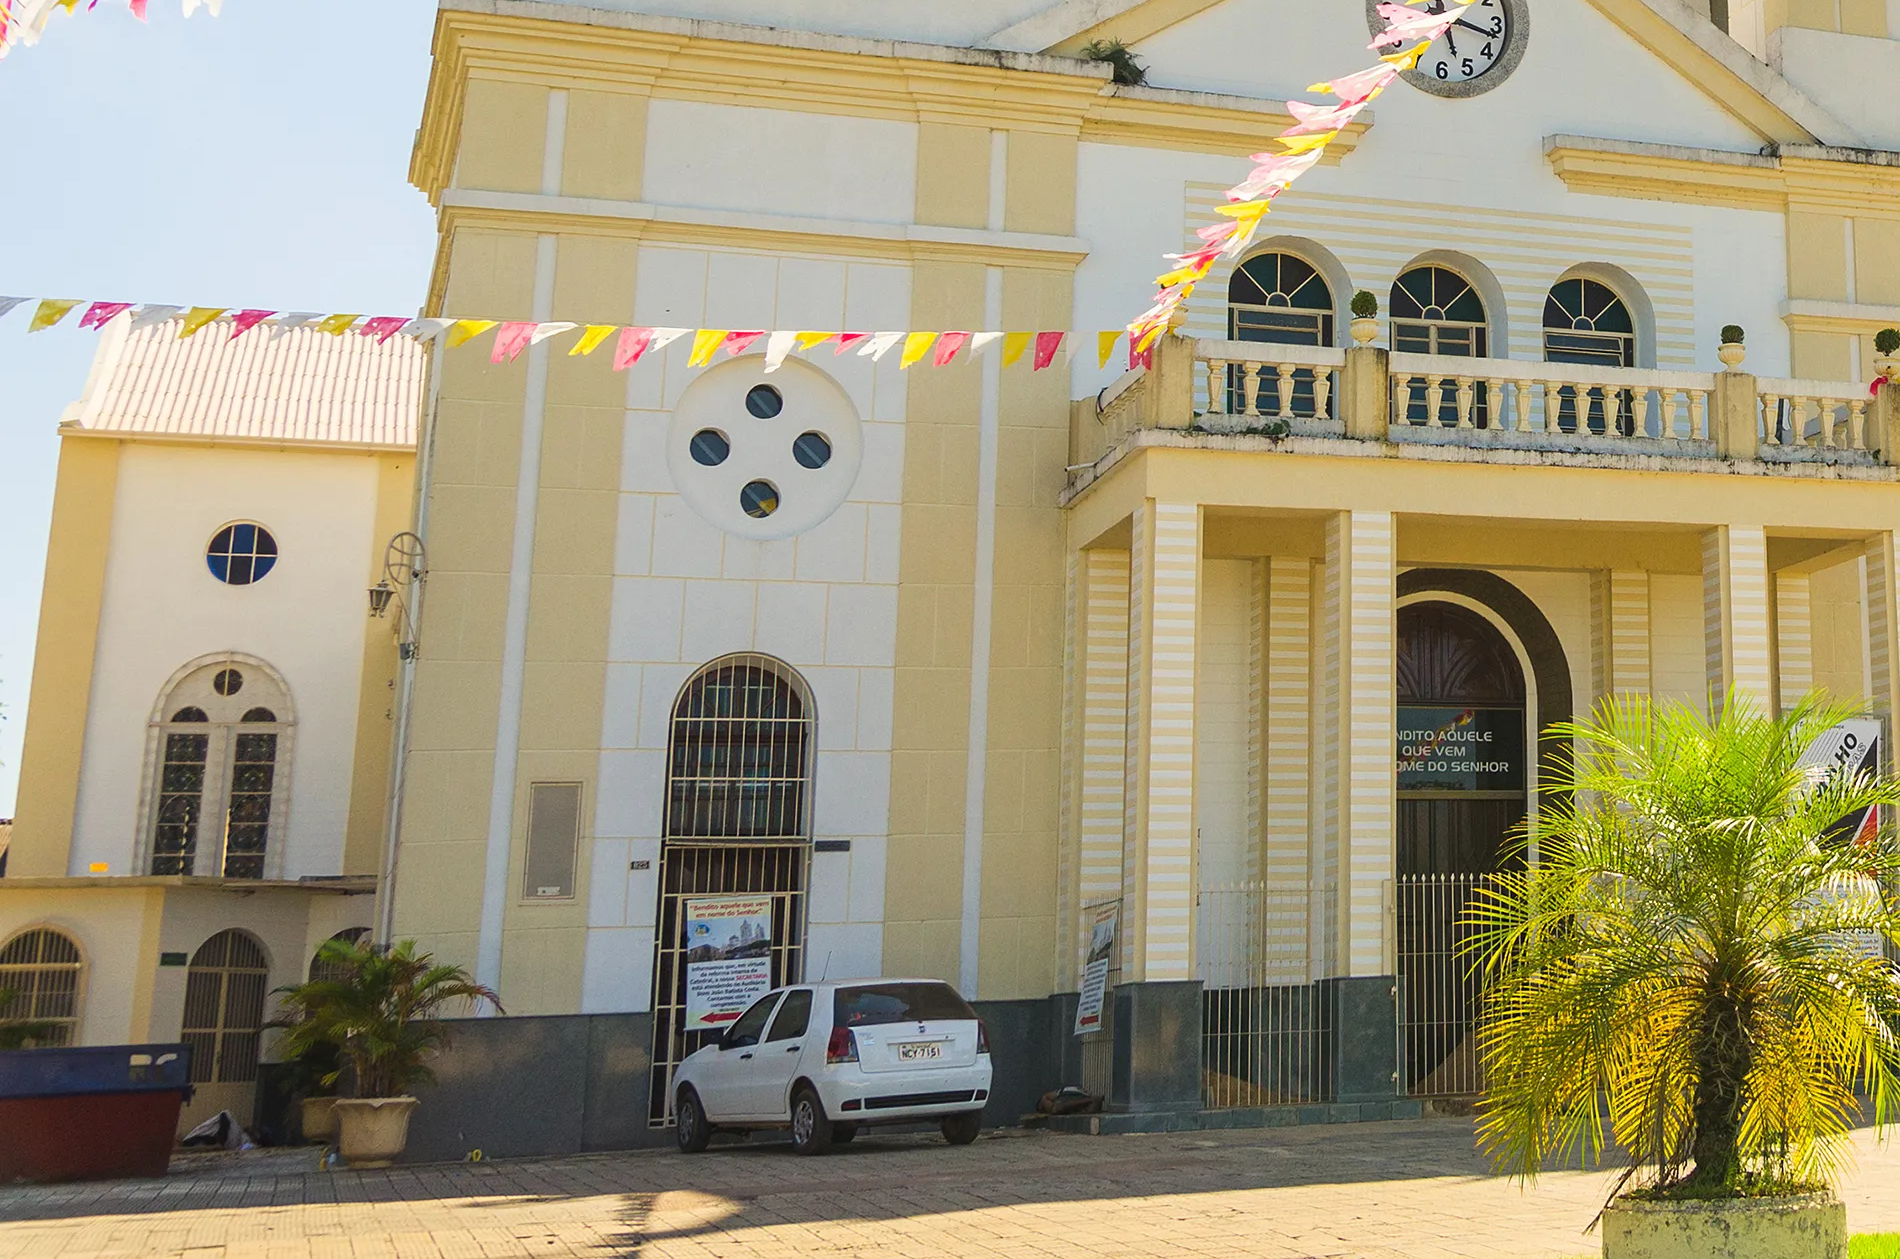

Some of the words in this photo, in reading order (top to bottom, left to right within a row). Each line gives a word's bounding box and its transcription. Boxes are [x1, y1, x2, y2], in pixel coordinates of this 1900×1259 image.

[1490, 15, 1502, 36] 3
[1480, 41, 1494, 60] 4
[1435, 61, 1449, 79] 6
[1461, 58, 1474, 76] 5
[1437, 730, 1493, 742] AQUELE
[1402, 745, 1431, 756] QUE
[1434, 745, 1466, 757] VEM
[1427, 761, 1447, 772] DO
[1450, 761, 1509, 773] SENHOR
